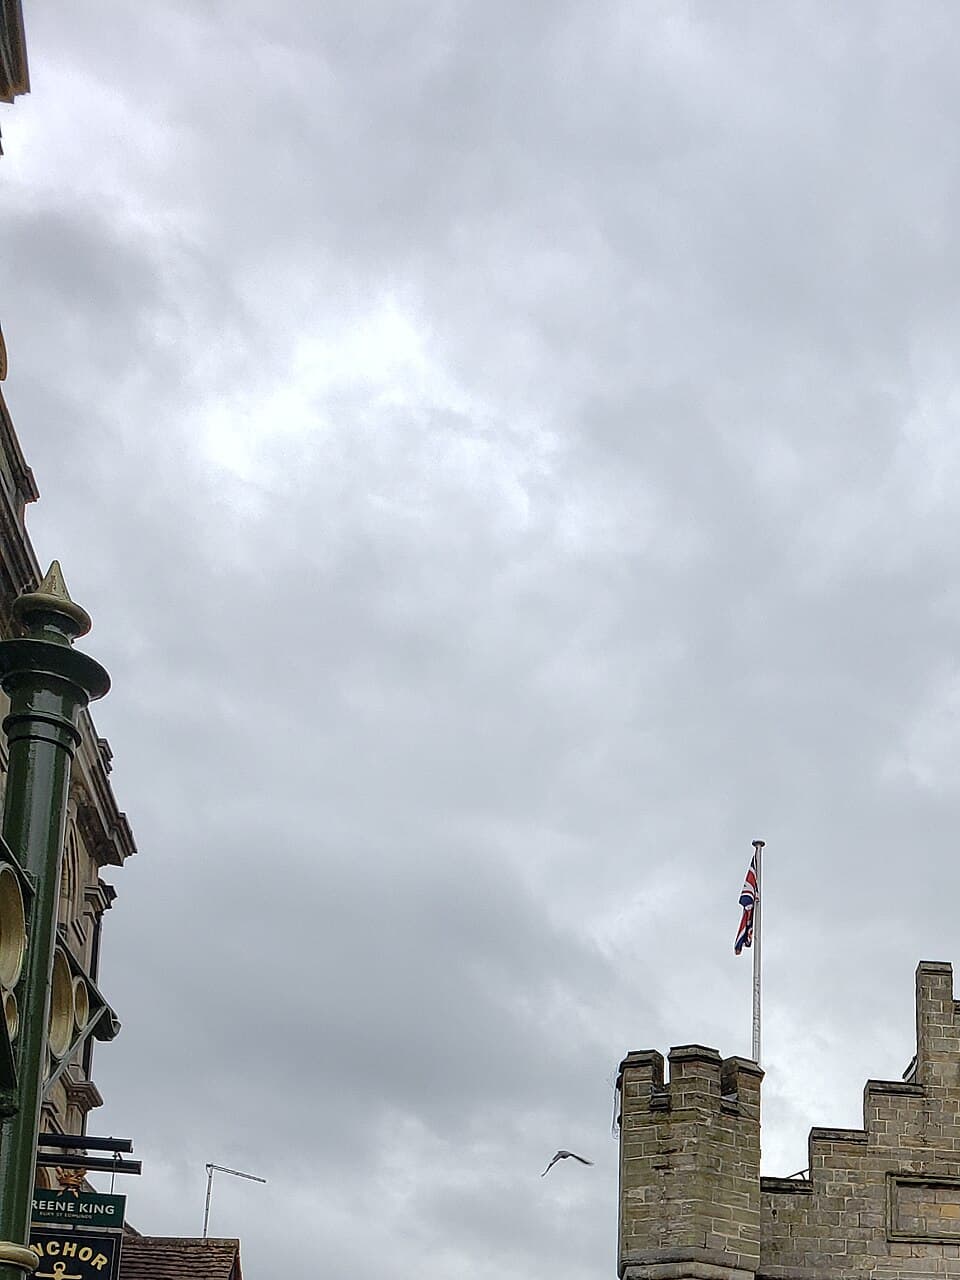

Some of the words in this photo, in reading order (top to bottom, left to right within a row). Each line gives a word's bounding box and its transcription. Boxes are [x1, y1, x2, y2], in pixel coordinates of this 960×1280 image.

[31, 1200, 75, 1212] REENE
[79, 1203, 115, 1215] KING
[29, 1241, 108, 1271] NCHOR
